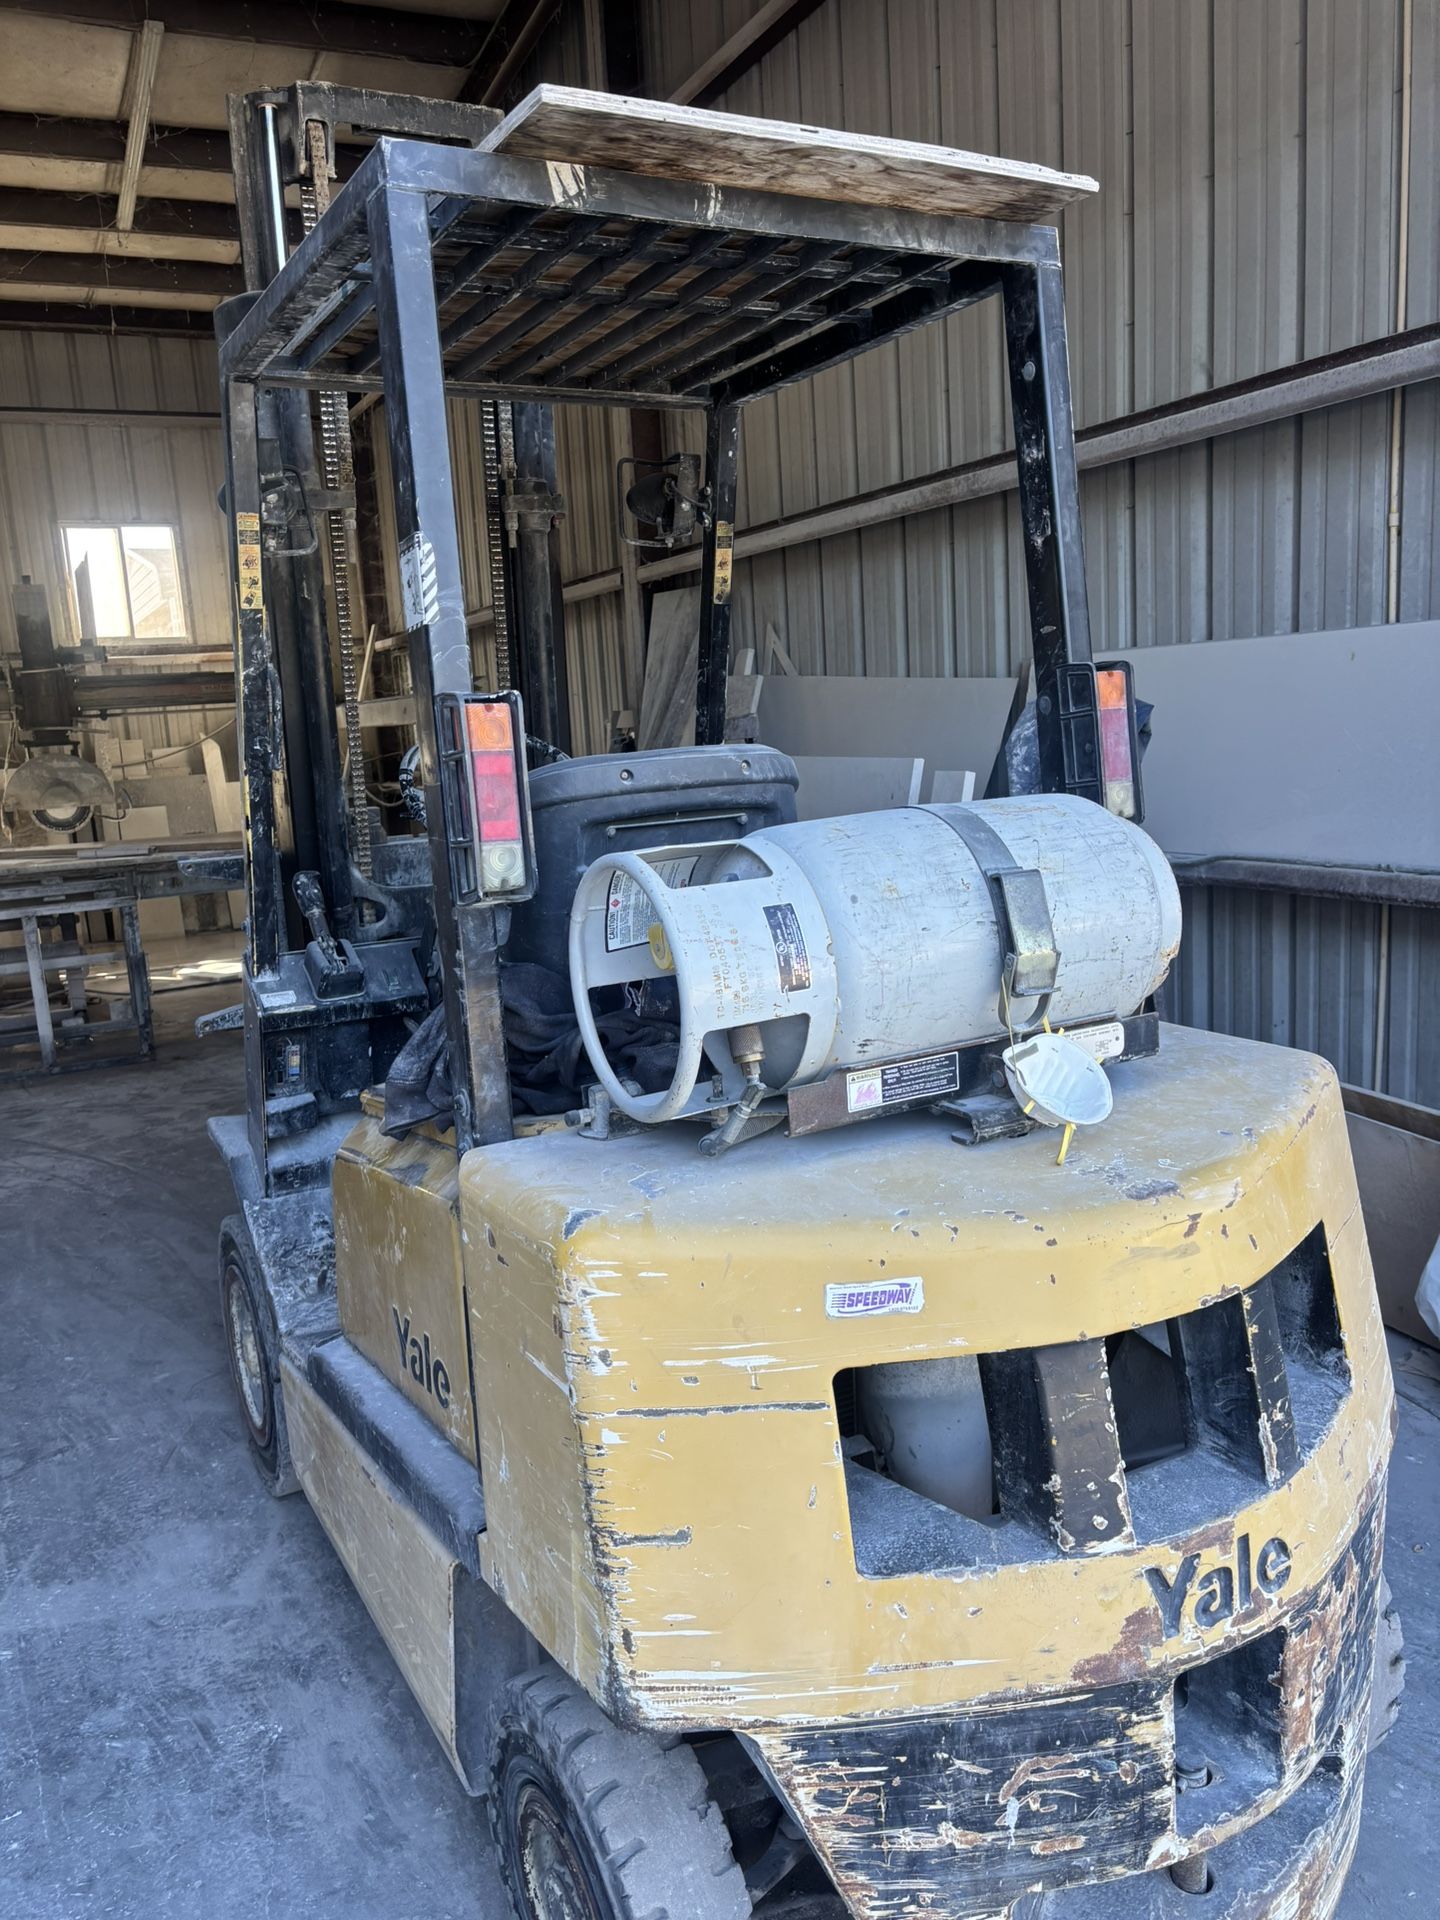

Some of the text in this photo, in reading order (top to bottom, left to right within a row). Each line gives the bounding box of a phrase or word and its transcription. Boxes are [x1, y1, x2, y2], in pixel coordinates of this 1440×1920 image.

[846, 1288, 912, 1308] SPEEDWAY
[391, 1304, 452, 1409] Yale
[1142, 1532, 1292, 1640] Yale
